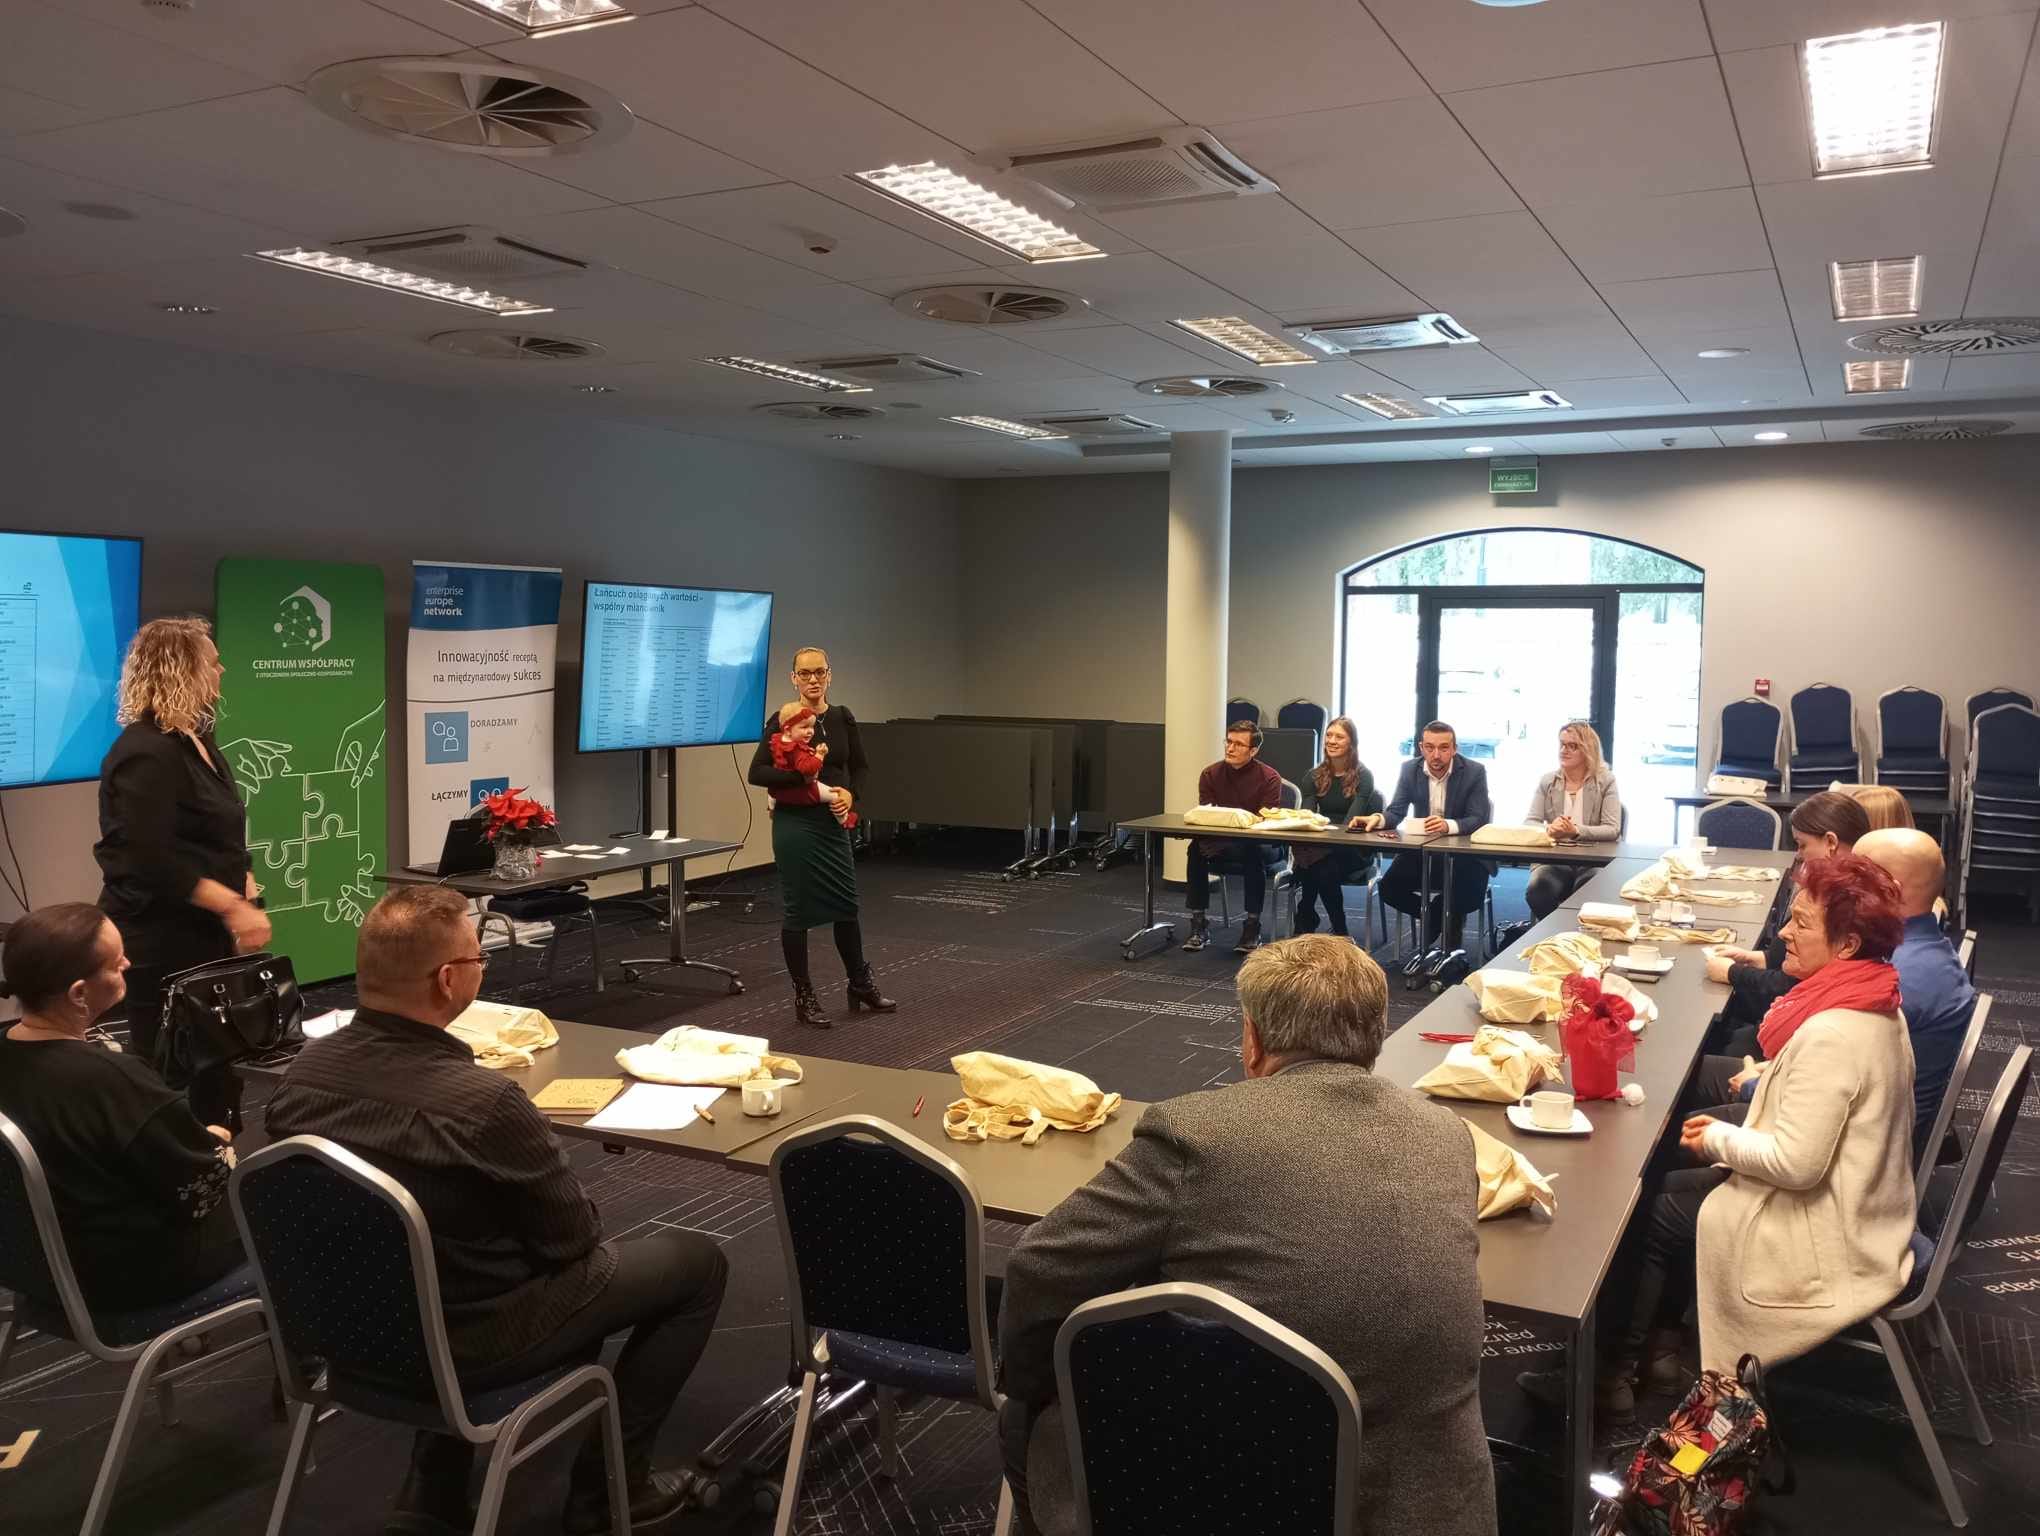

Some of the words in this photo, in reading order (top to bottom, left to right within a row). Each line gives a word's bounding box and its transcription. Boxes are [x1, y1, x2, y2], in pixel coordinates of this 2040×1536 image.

[425, 586, 464, 596] enterprise
[670, 592, 699, 602] wartości
[425, 598, 454, 607] europe
[424, 608, 464, 616] network
[438, 650, 510, 664] Innowacyjność
[512, 653, 538, 664] receptą
[252, 659, 298, 670] CENTRUM
[298, 657, 355, 668] WSPÓŁPRACY
[433, 674, 445, 683] na
[447, 672, 511, 684] międzynarodowy
[513, 669, 542, 681] sukces
[470, 718, 519, 728] DORADZAMY
[431, 790, 469, 802] ŁĄCZYMY
